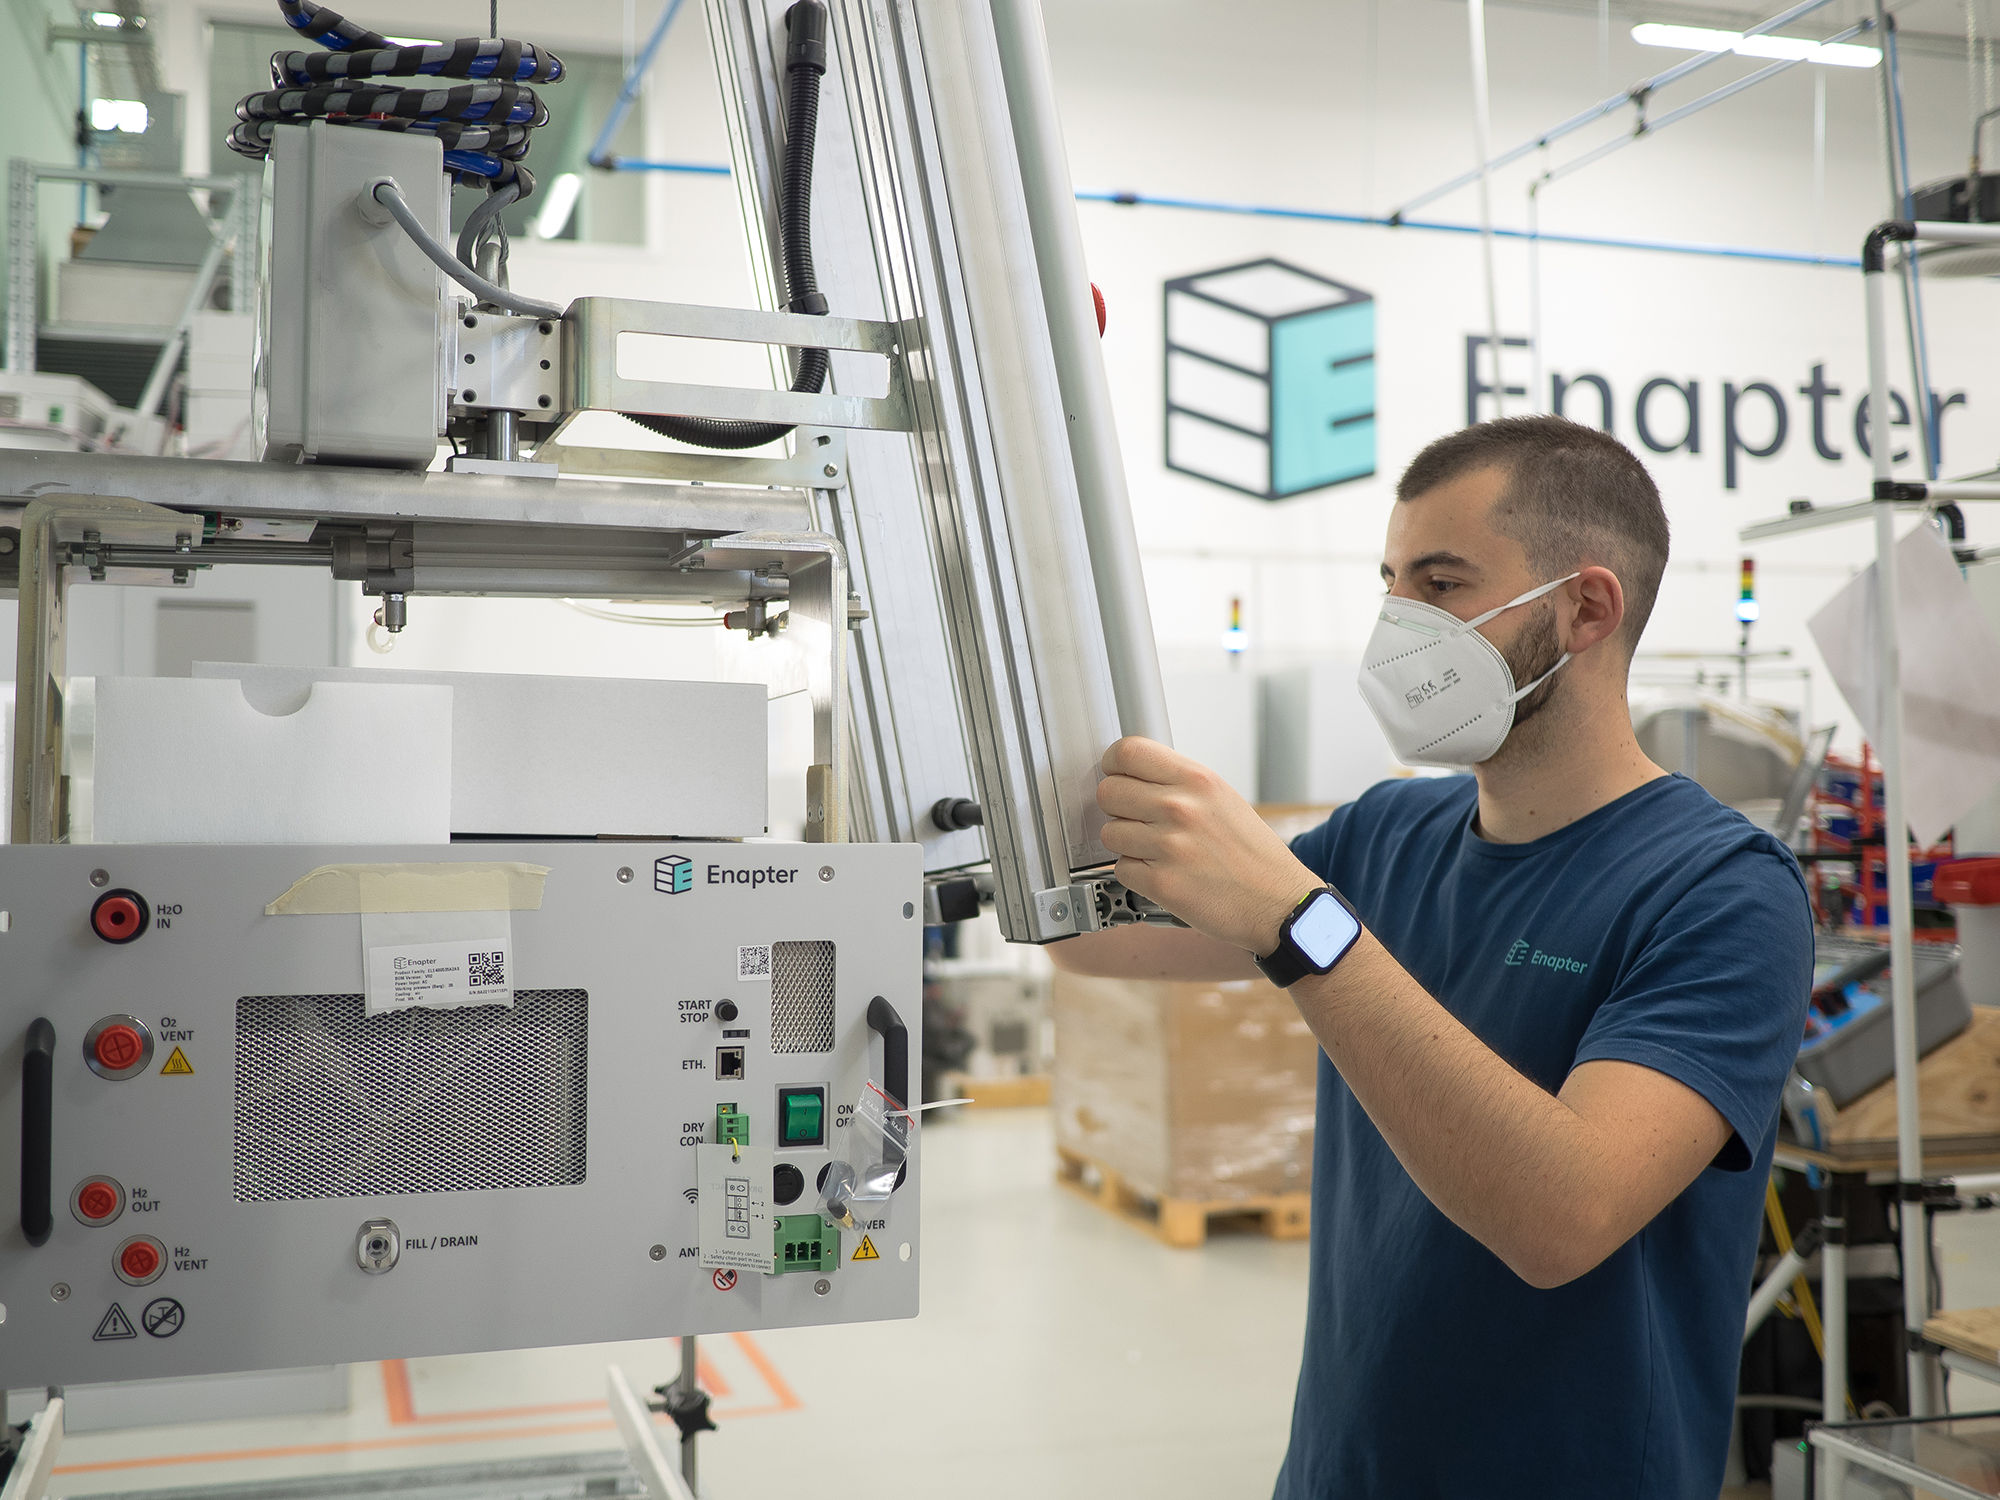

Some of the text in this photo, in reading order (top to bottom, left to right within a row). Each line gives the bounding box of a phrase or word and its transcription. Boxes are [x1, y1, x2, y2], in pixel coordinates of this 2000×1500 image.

[1465, 335, 1967, 490] Enapter
[707, 864, 799, 889] Enapter
[157, 904, 183, 915] H2O
[157, 918, 171, 929] IN
[1531, 949, 1588, 974] Enapter
[678, 1000, 712, 1011] START
[160, 1017, 177, 1028] O2
[680, 1012, 709, 1023] STOP
[160, 1030, 194, 1041] VENT
[682, 1059, 706, 1070] ETH.
[837, 1104, 854, 1115] ON
[683, 1122, 705, 1133] DRY
[132, 1188, 148, 1198] H2
[132, 1200, 160, 1213] OUT
[851, 1219, 886, 1231] OWER
[405, 1235, 478, 1250] FILL / DRAIN
[174, 1247, 190, 1257] H2
[174, 1259, 208, 1271] VENT
